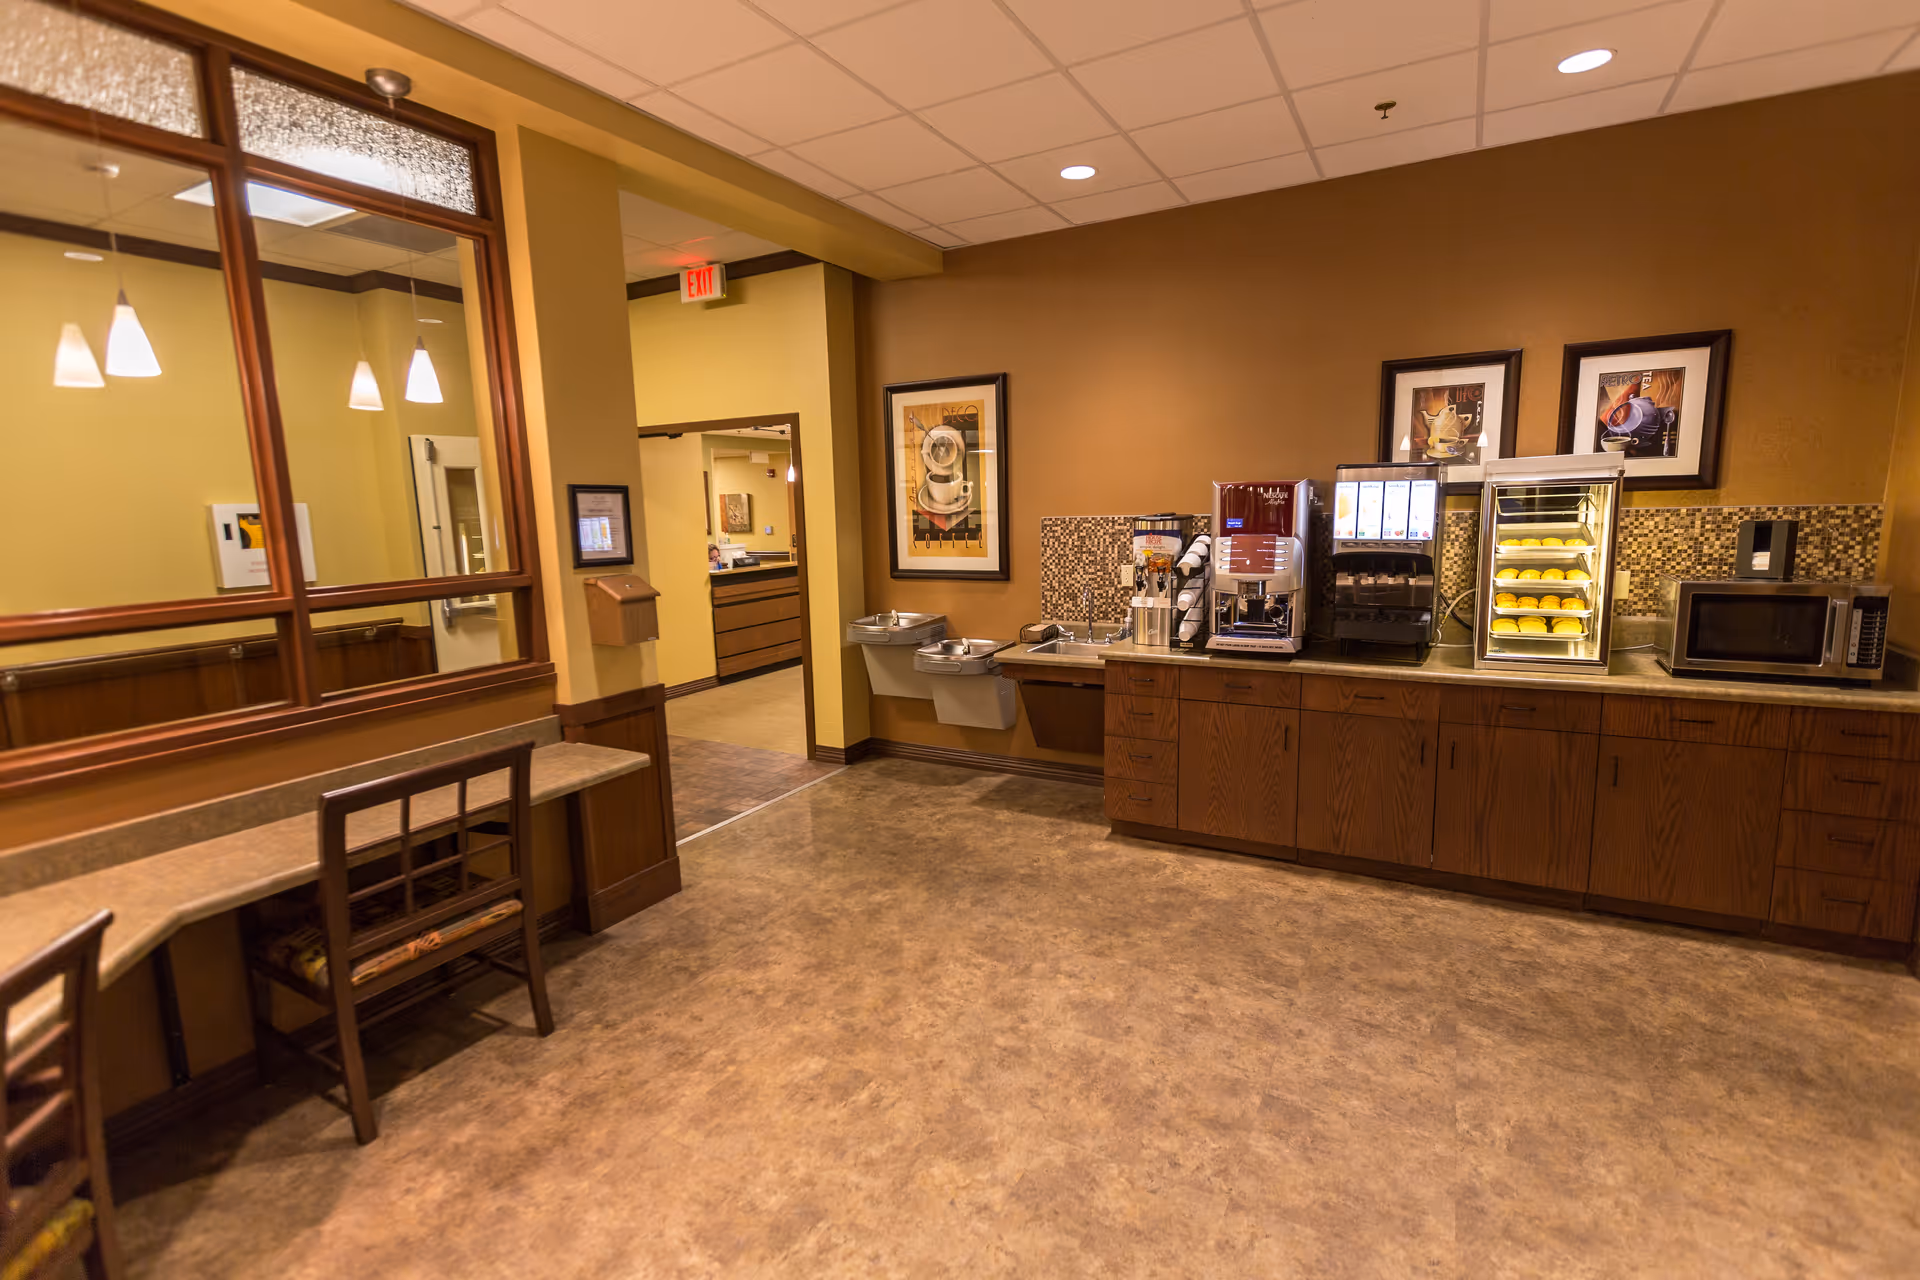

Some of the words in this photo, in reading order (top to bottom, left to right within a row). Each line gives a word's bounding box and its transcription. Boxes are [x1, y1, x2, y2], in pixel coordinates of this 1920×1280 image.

[687, 266, 713, 298] EXIT
[1600, 373, 1643, 388] RETRO
[1642, 371, 1653, 391] TEA
[1456, 387, 1483, 402] DECO
[942, 405, 979, 425] DECO
[912, 532, 983, 549] COFFEE
